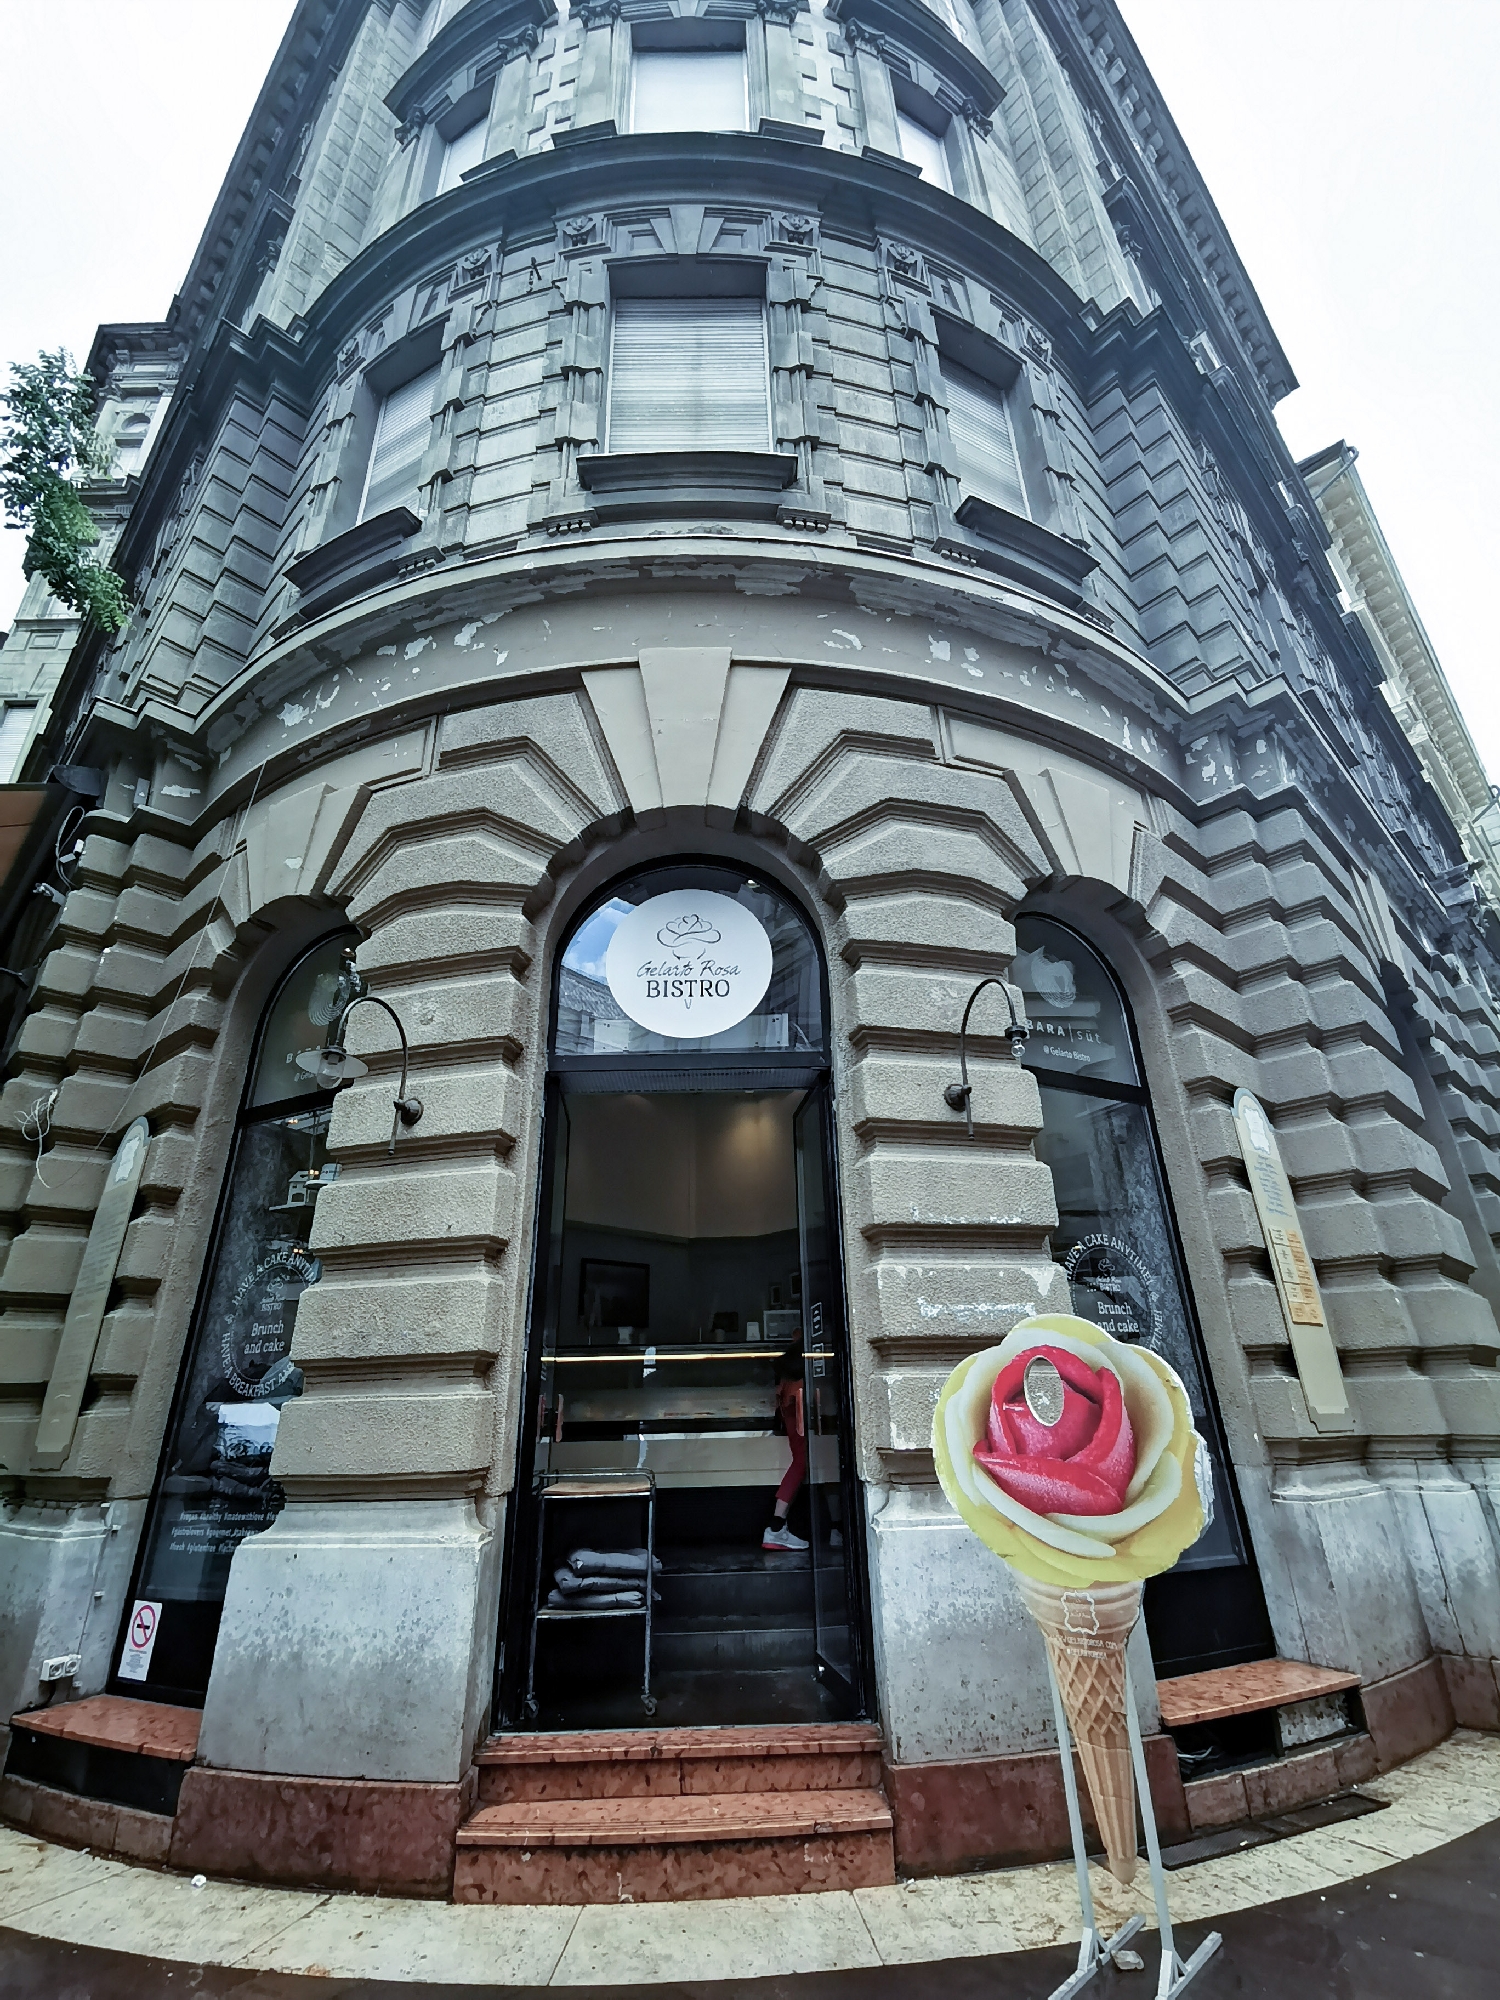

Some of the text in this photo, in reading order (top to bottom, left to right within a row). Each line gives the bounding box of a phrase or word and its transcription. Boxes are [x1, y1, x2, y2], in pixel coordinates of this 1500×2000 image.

[700, 959, 742, 976] Rosa
[646, 979, 730, 998] BISTRO
[1024, 1019, 1065, 1038] BARA
[1084, 1234, 1109, 1247] CAKE
[264, 1252, 289, 1269] CAKE
[1097, 1302, 1133, 1315] Brunch
[251, 1321, 284, 1337] Brunch
[1117, 1320, 1140, 1333] cake
[244, 1339, 285, 1355] and cake
[229, 1373, 276, 1397] BREAKFAST
